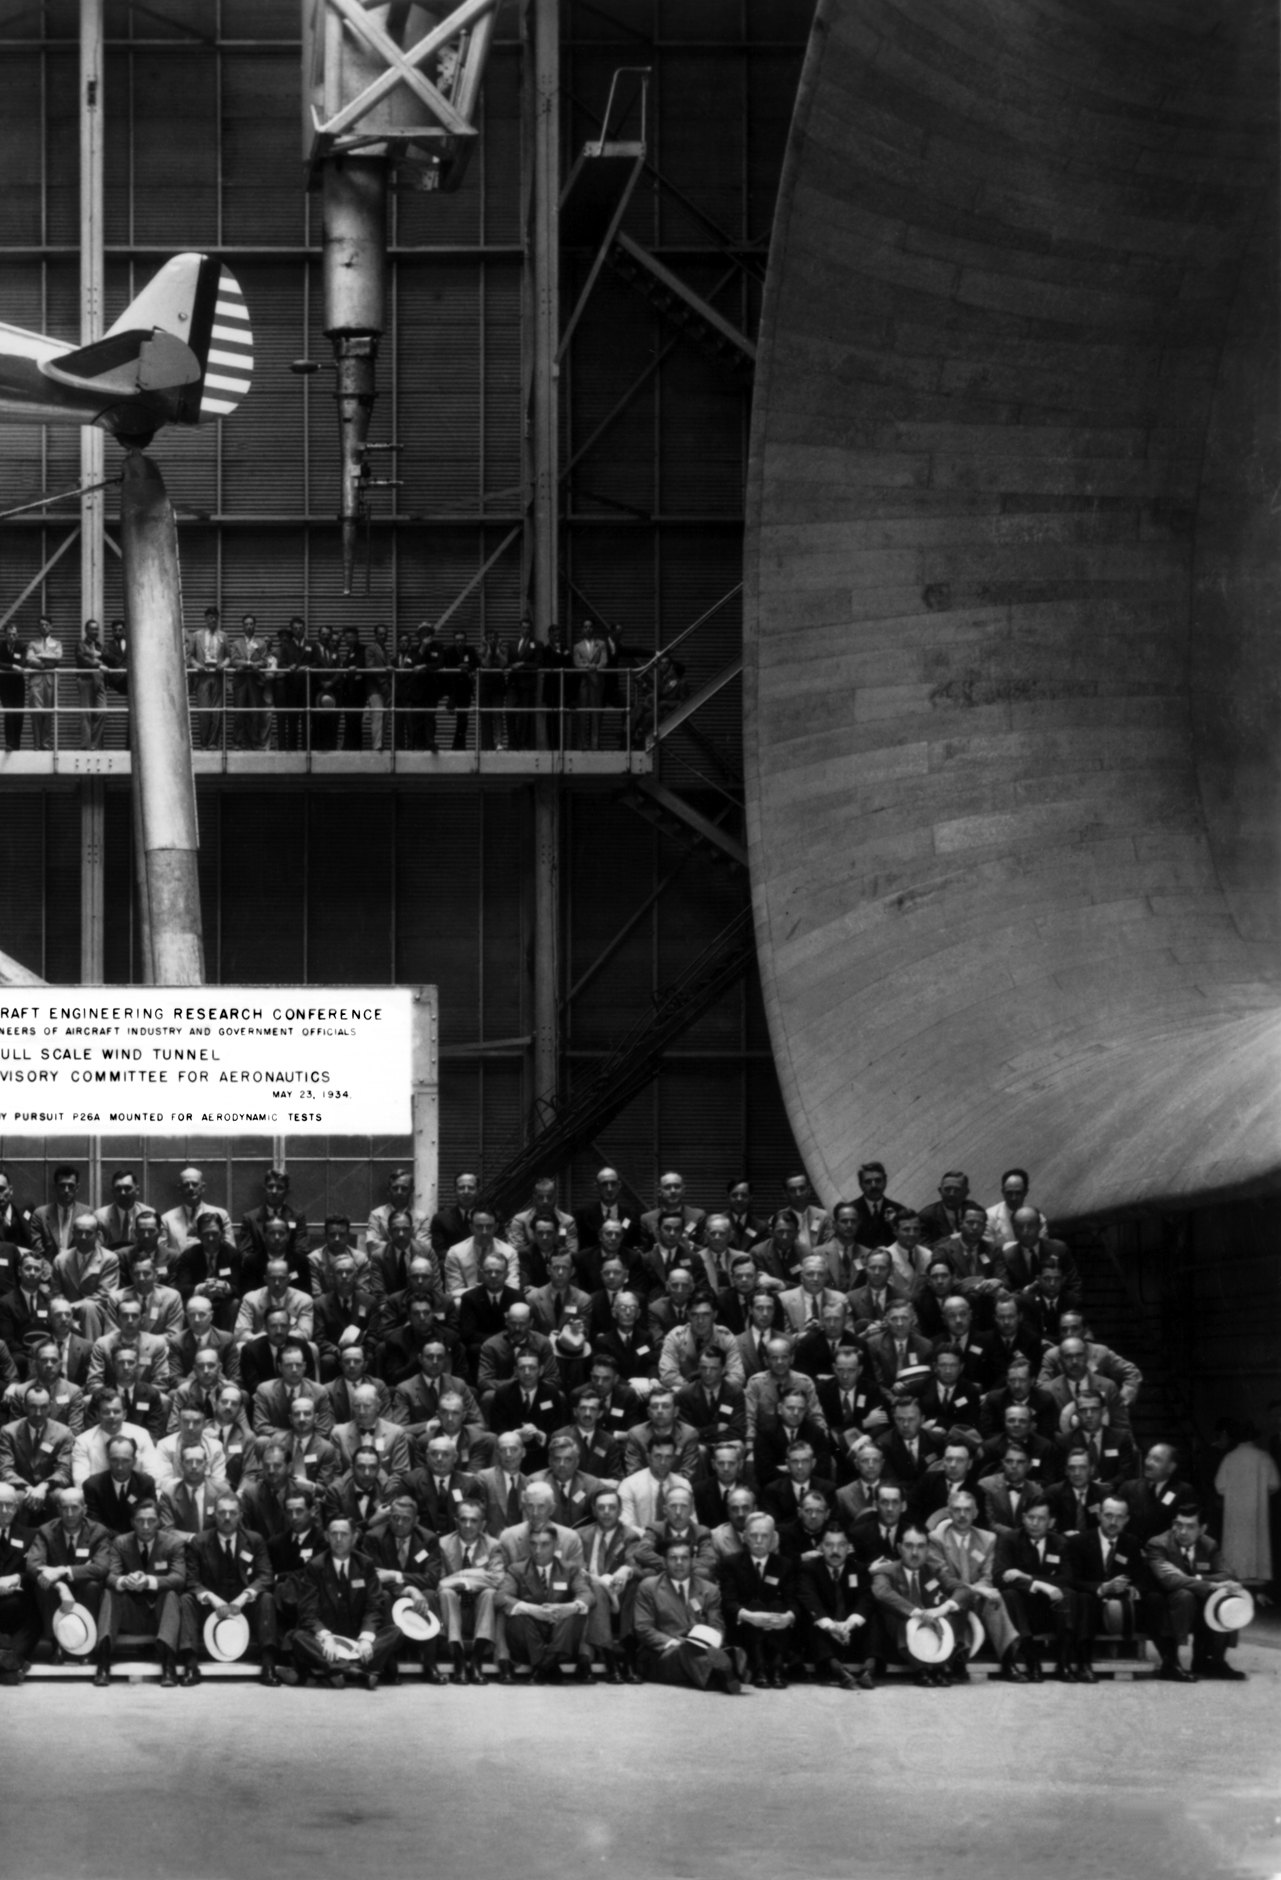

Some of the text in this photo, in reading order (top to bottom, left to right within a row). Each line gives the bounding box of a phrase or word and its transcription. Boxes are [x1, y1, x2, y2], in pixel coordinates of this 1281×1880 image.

[50, 1007, 164, 1020] ENGINEERING
[174, 1008, 263, 1020] RESEARCH
[273, 1008, 382, 1021] CONFERENCE
[43, 1027, 58, 1036] OF
[65, 1027, 120, 1036] AIRCRAFT
[127, 1027, 182, 1036] INDUSTRY
[189, 1027, 211, 1036] AND
[218, 1027, 293, 1037] GOVERNMENT
[302, 1027, 357, 1037] OFFICIALS
[40, 1048, 92, 1061] SCALE
[102, 1048, 142, 1061] WIND
[153, 1048, 220, 1061] TUNNEL
[71, 1070, 168, 1083] COMMITTEE
[178, 1071, 209, 1083] FOR
[219, 1071, 330, 1084] AERONAUTICS
[272, 1090, 293, 1098] MAY
[14, 1112, 64, 1122] PURSUIT
[72, 1112, 101, 1122] P26A
[110, 1113, 164, 1122] MOUNTED
[171, 1113, 193, 1122] FOR
[201, 1113, 278, 1122] AERODYNAMIC
[288, 1113, 323, 1122] TESTS
